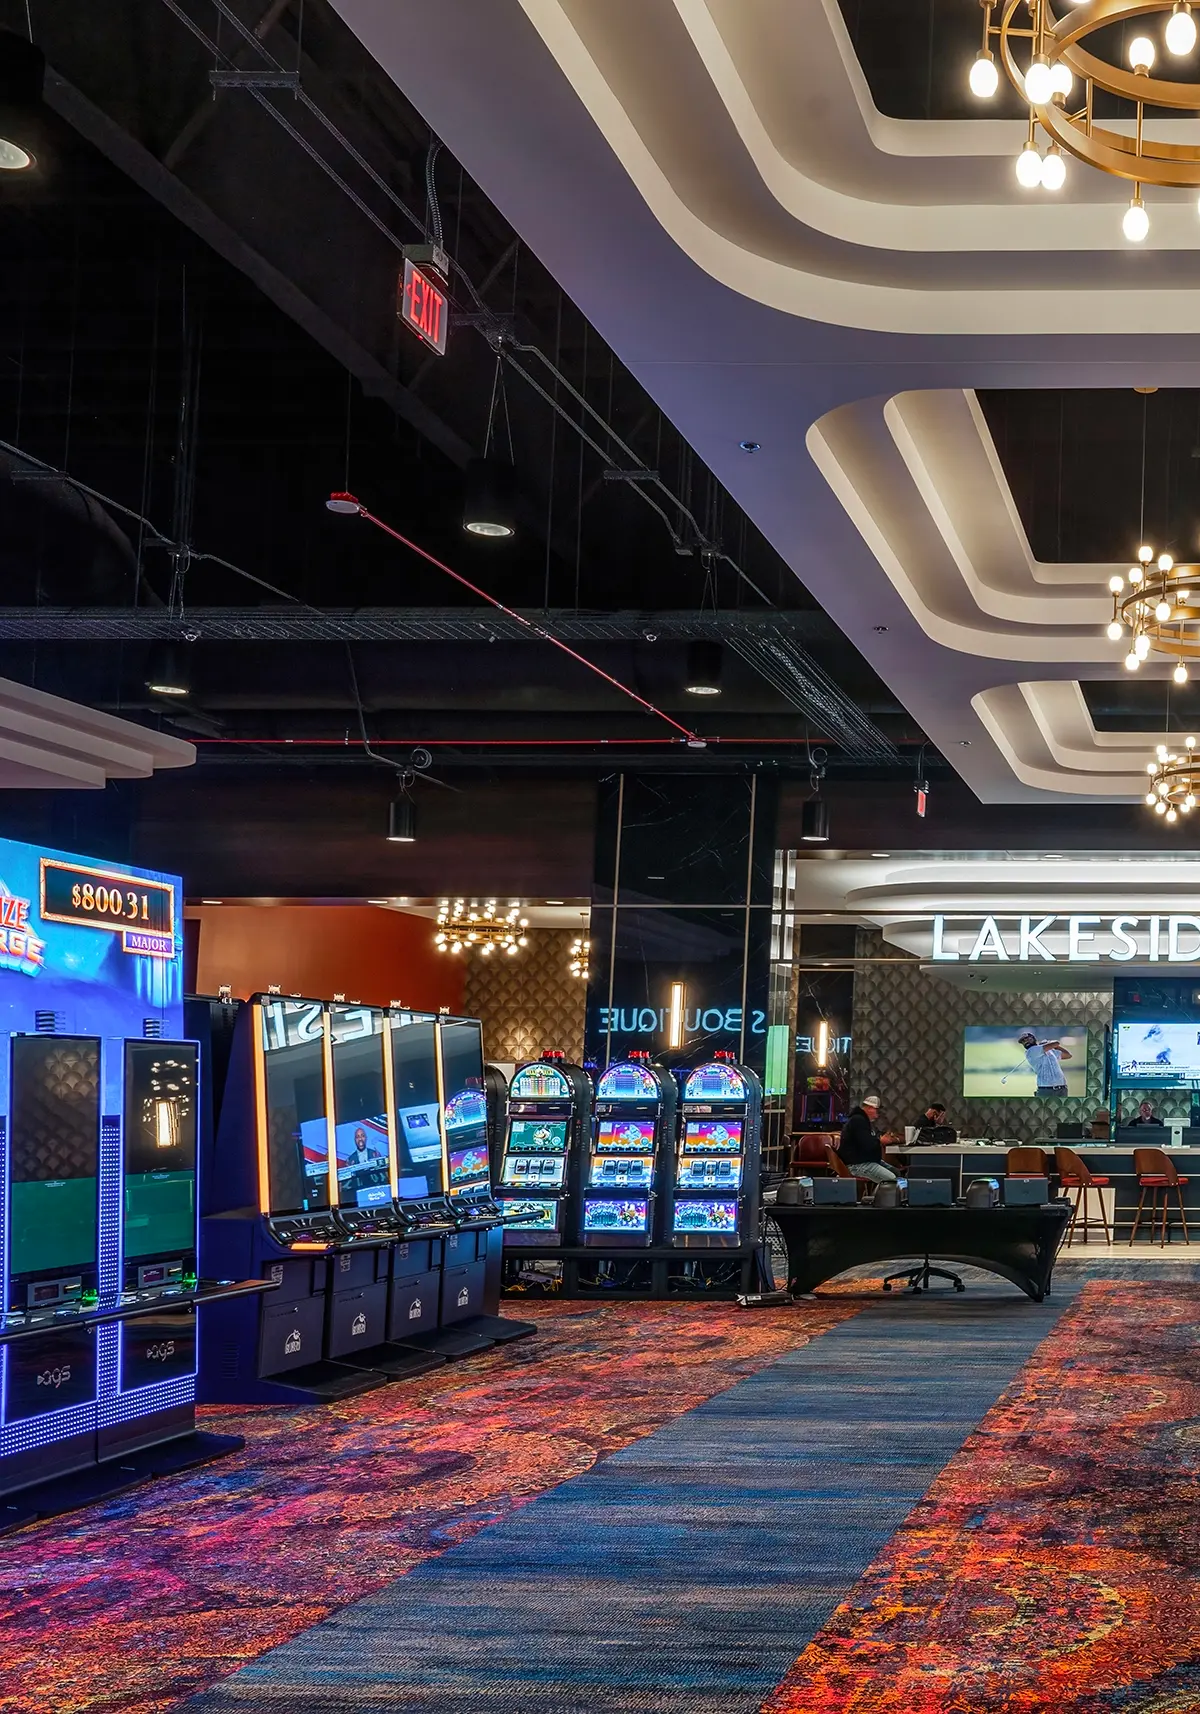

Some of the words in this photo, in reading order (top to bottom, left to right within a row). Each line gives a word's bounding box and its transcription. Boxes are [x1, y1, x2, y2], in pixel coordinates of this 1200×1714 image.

[410, 271, 443, 344] EXIT
[72, 883, 150, 921] $800.31
[131, 934, 168, 952] MAJOR
